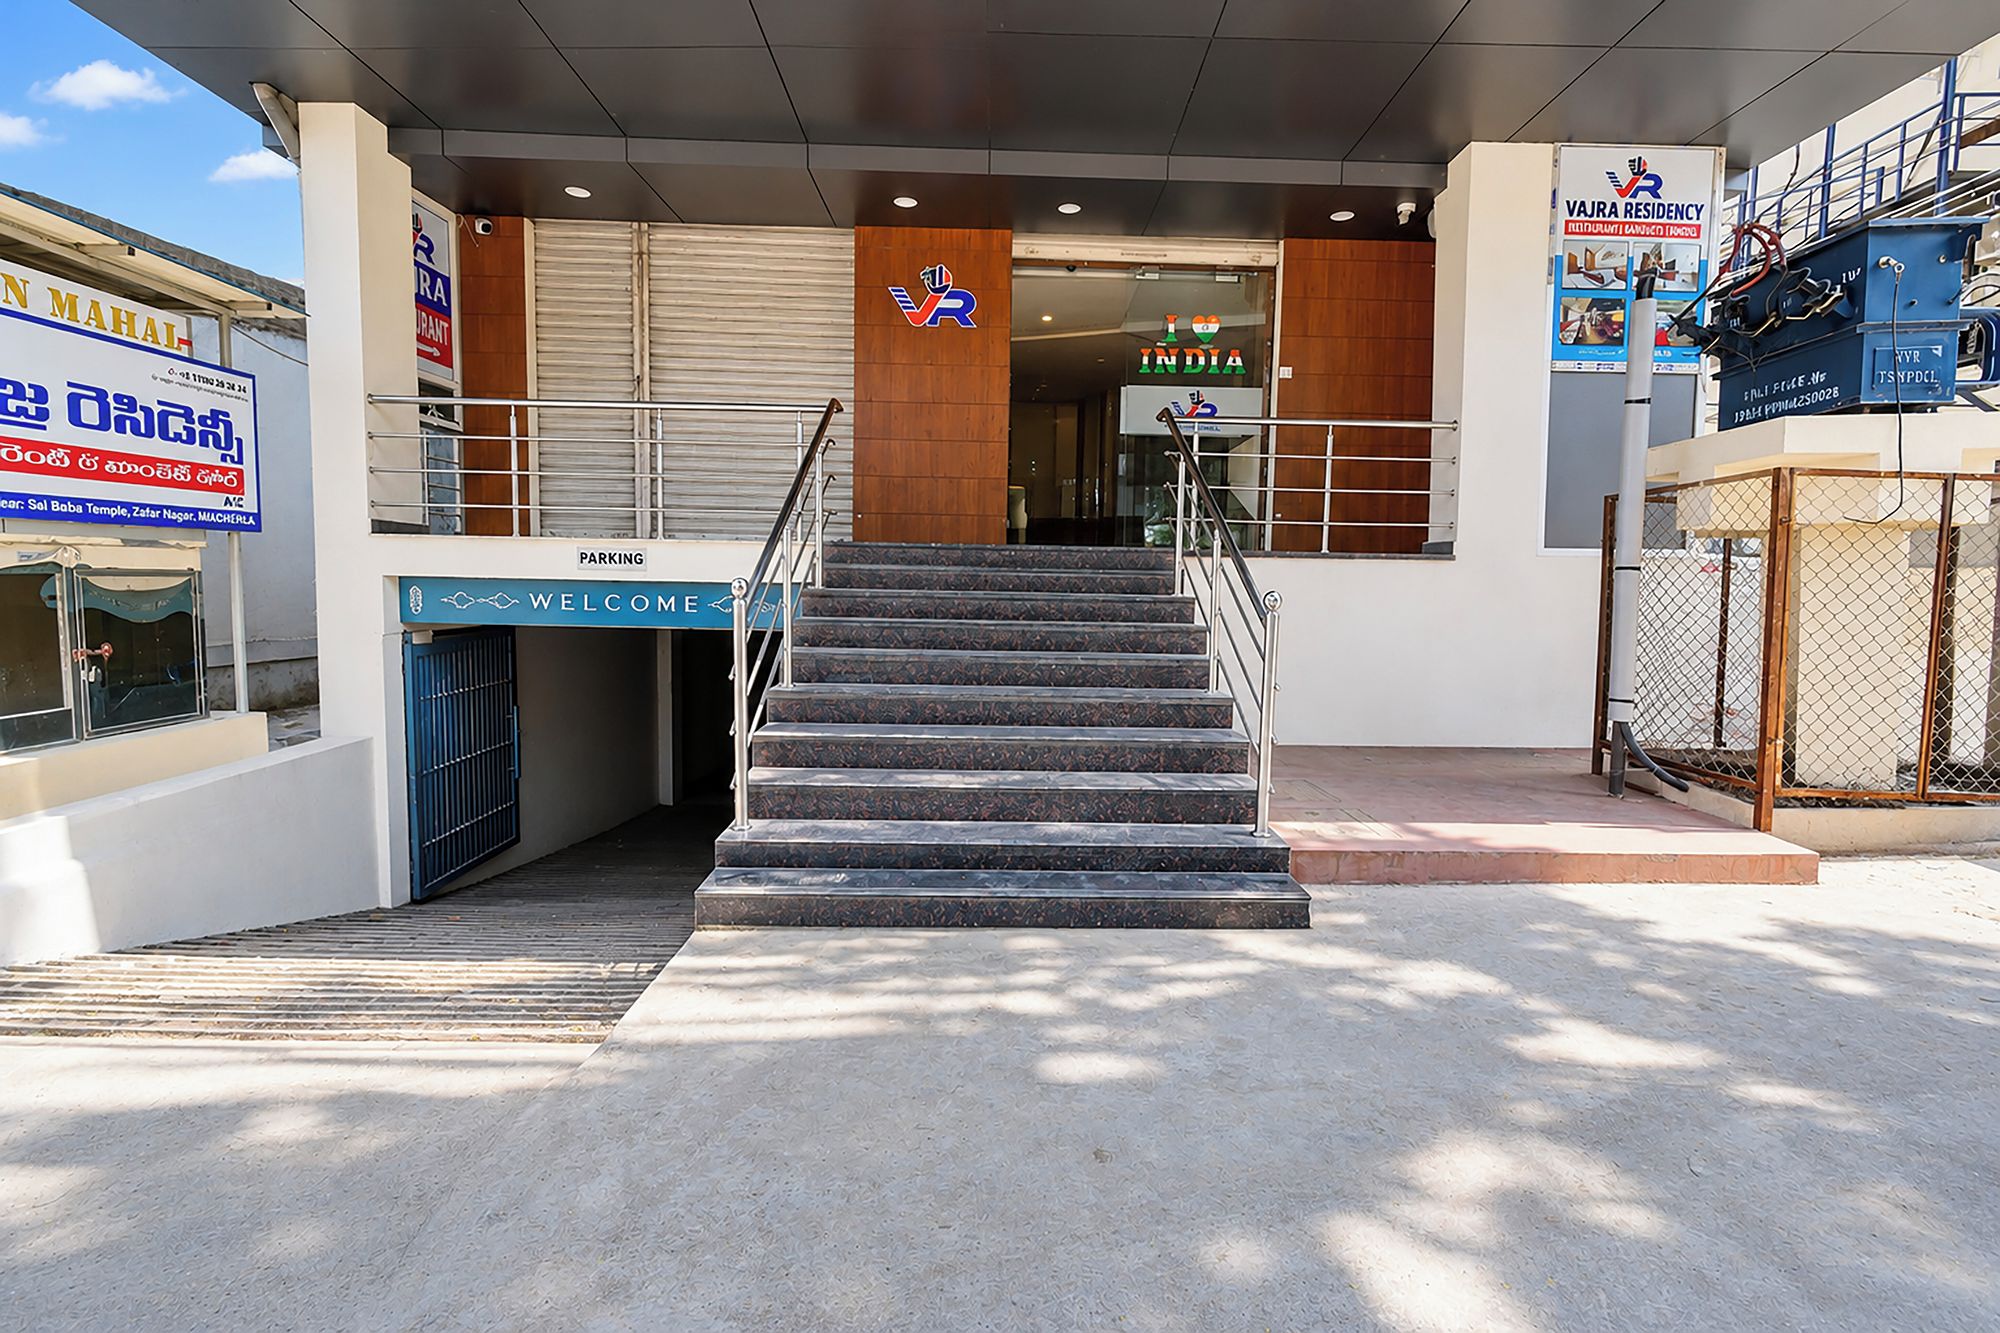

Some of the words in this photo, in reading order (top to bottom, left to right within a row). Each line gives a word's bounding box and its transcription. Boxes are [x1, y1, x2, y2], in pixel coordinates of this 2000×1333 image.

[1565, 200, 1619, 218] VAJRA
[1623, 202, 1705, 221] RESIDENCY
[47, 287, 182, 351] MAHAL
[1163, 314, 1179, 343] I
[1138, 348, 1247, 374] INDIA
[579, 552, 644, 566] PARKING
[528, 592, 699, 613] WELCOME
